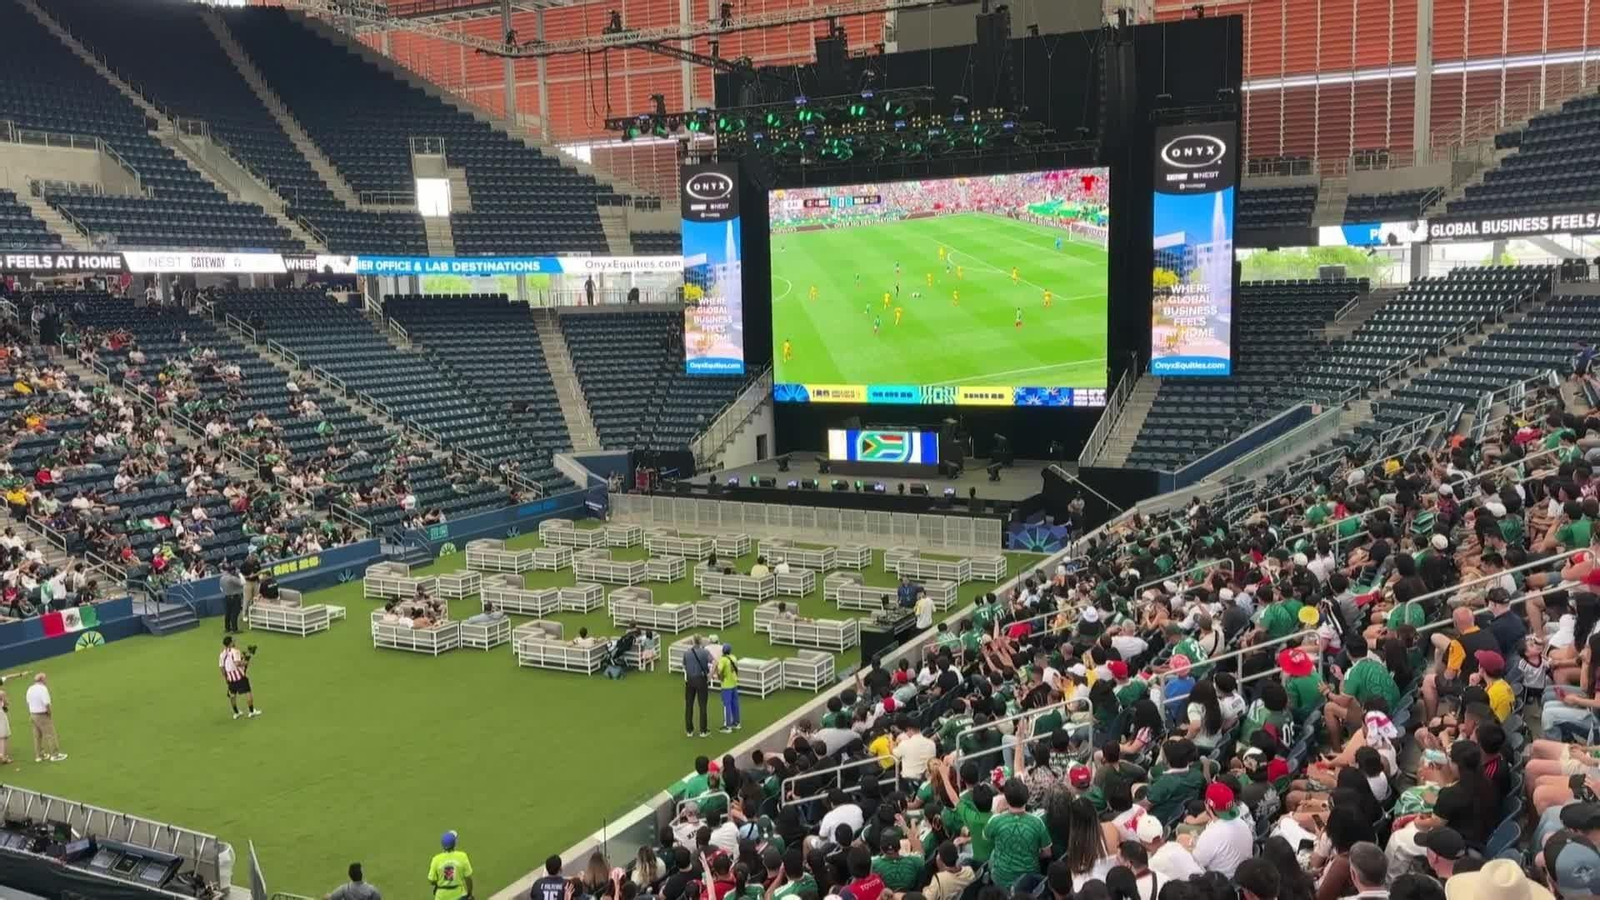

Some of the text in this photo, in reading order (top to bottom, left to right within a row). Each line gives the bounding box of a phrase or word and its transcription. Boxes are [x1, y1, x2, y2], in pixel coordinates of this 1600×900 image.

[1172, 145, 1215, 157] ONYX
[693, 181, 725, 191] ONYX
[1431, 213, 1595, 237] GLOBAL BUSINESS FEELS
[6, 255, 53, 269] FEELS
[56, 256, 74, 269] AT
[77, 256, 122, 269] HOME
[190, 256, 226, 269] GATEWAY
[375, 260, 412, 271] OFFICE
[413, 259, 422, 272] &
[425, 261, 449, 272] LAB
[452, 262, 541, 272] DESTINATIONS
[584, 259, 681, 270] OnyxEquities.com
[1170, 283, 1211, 294] WHERE
[1168, 295, 1211, 304] GLOBAL
[696, 306, 728, 315] GLOBAL
[1163, 305, 1218, 316] BUSINESS
[1173, 317, 1207, 327] FEELS
[1180, 327, 1216, 338] HOME
[690, 362, 741, 370] OnyxEquities.com
[1155, 361, 1226, 370] OnyxEquities.com
